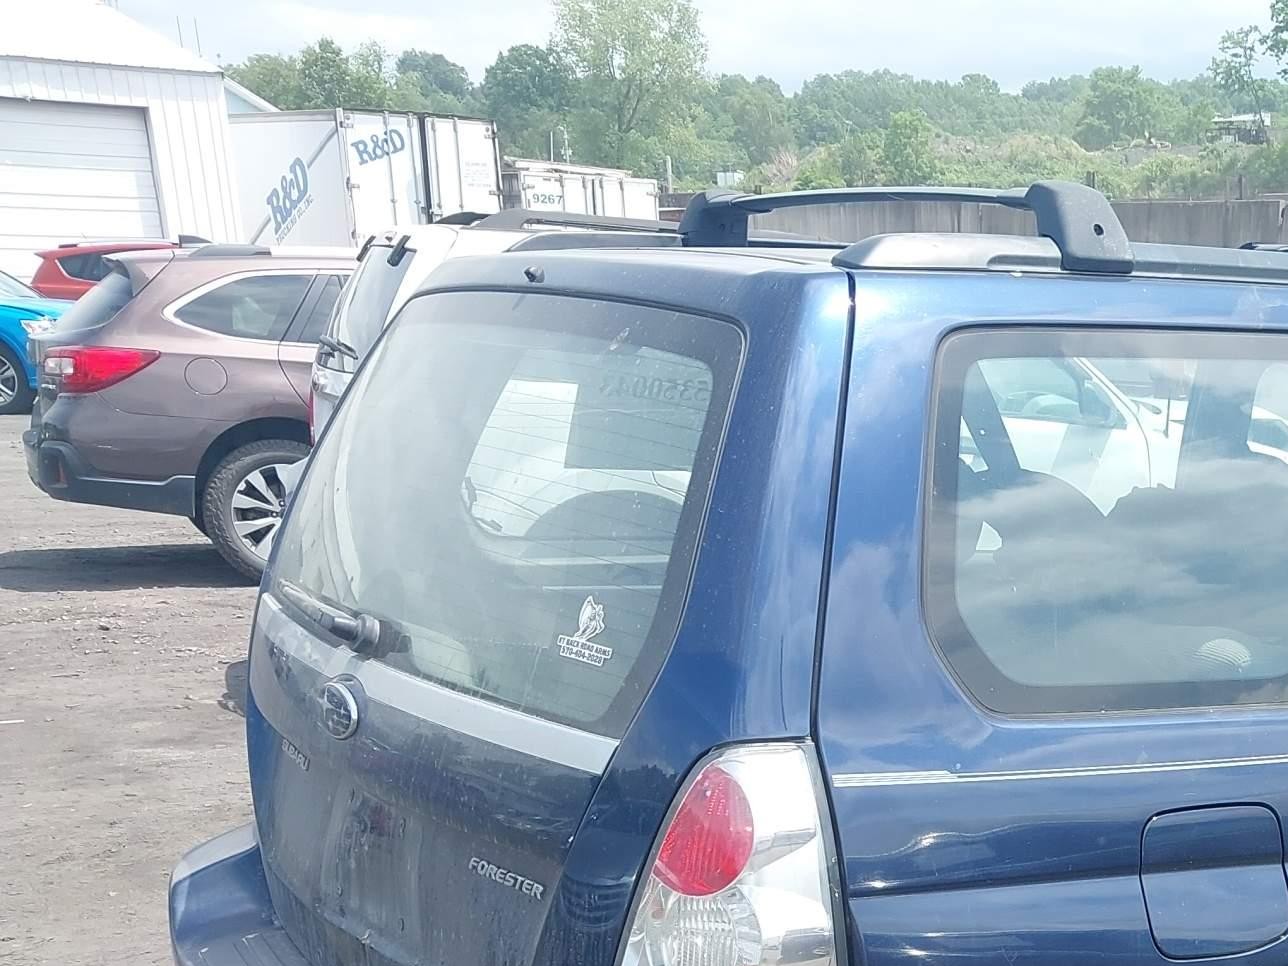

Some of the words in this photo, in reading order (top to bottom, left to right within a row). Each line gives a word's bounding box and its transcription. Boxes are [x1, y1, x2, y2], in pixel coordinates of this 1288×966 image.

[351, 129, 405, 166] R&D
[266, 157, 308, 235] R&D
[532, 193, 563, 205] 9267
[468, 856, 545, 900] FORESTER
